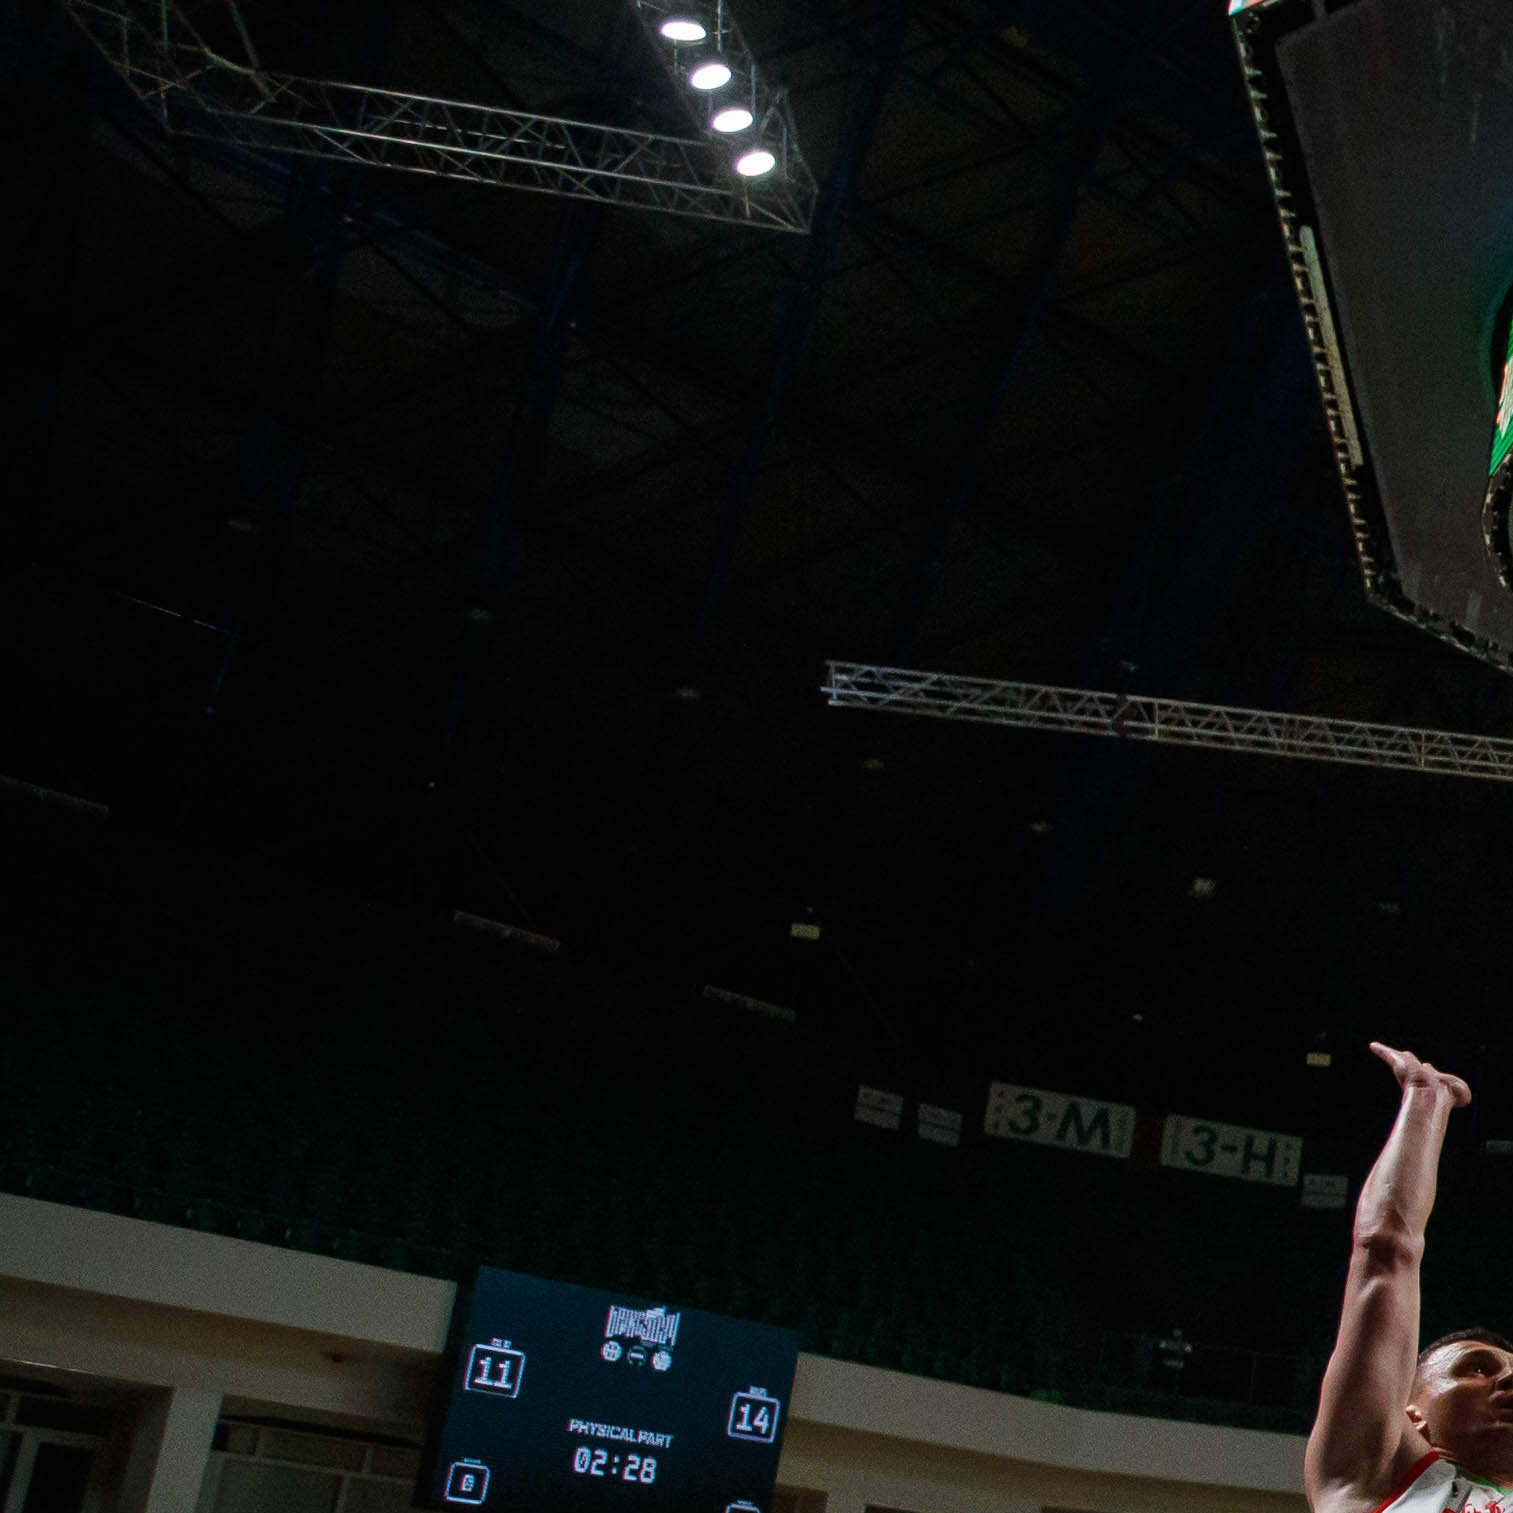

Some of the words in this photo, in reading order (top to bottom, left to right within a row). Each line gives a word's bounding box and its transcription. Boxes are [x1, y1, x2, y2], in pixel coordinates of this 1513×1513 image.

[473, 1356, 513, 1389] 11
[567, 1417, 637, 1445] PHYSICAL
[638, 1430, 675, 1449] PART
[735, 1403, 769, 1435] 14
[572, 1446, 657, 1484] 02:28
